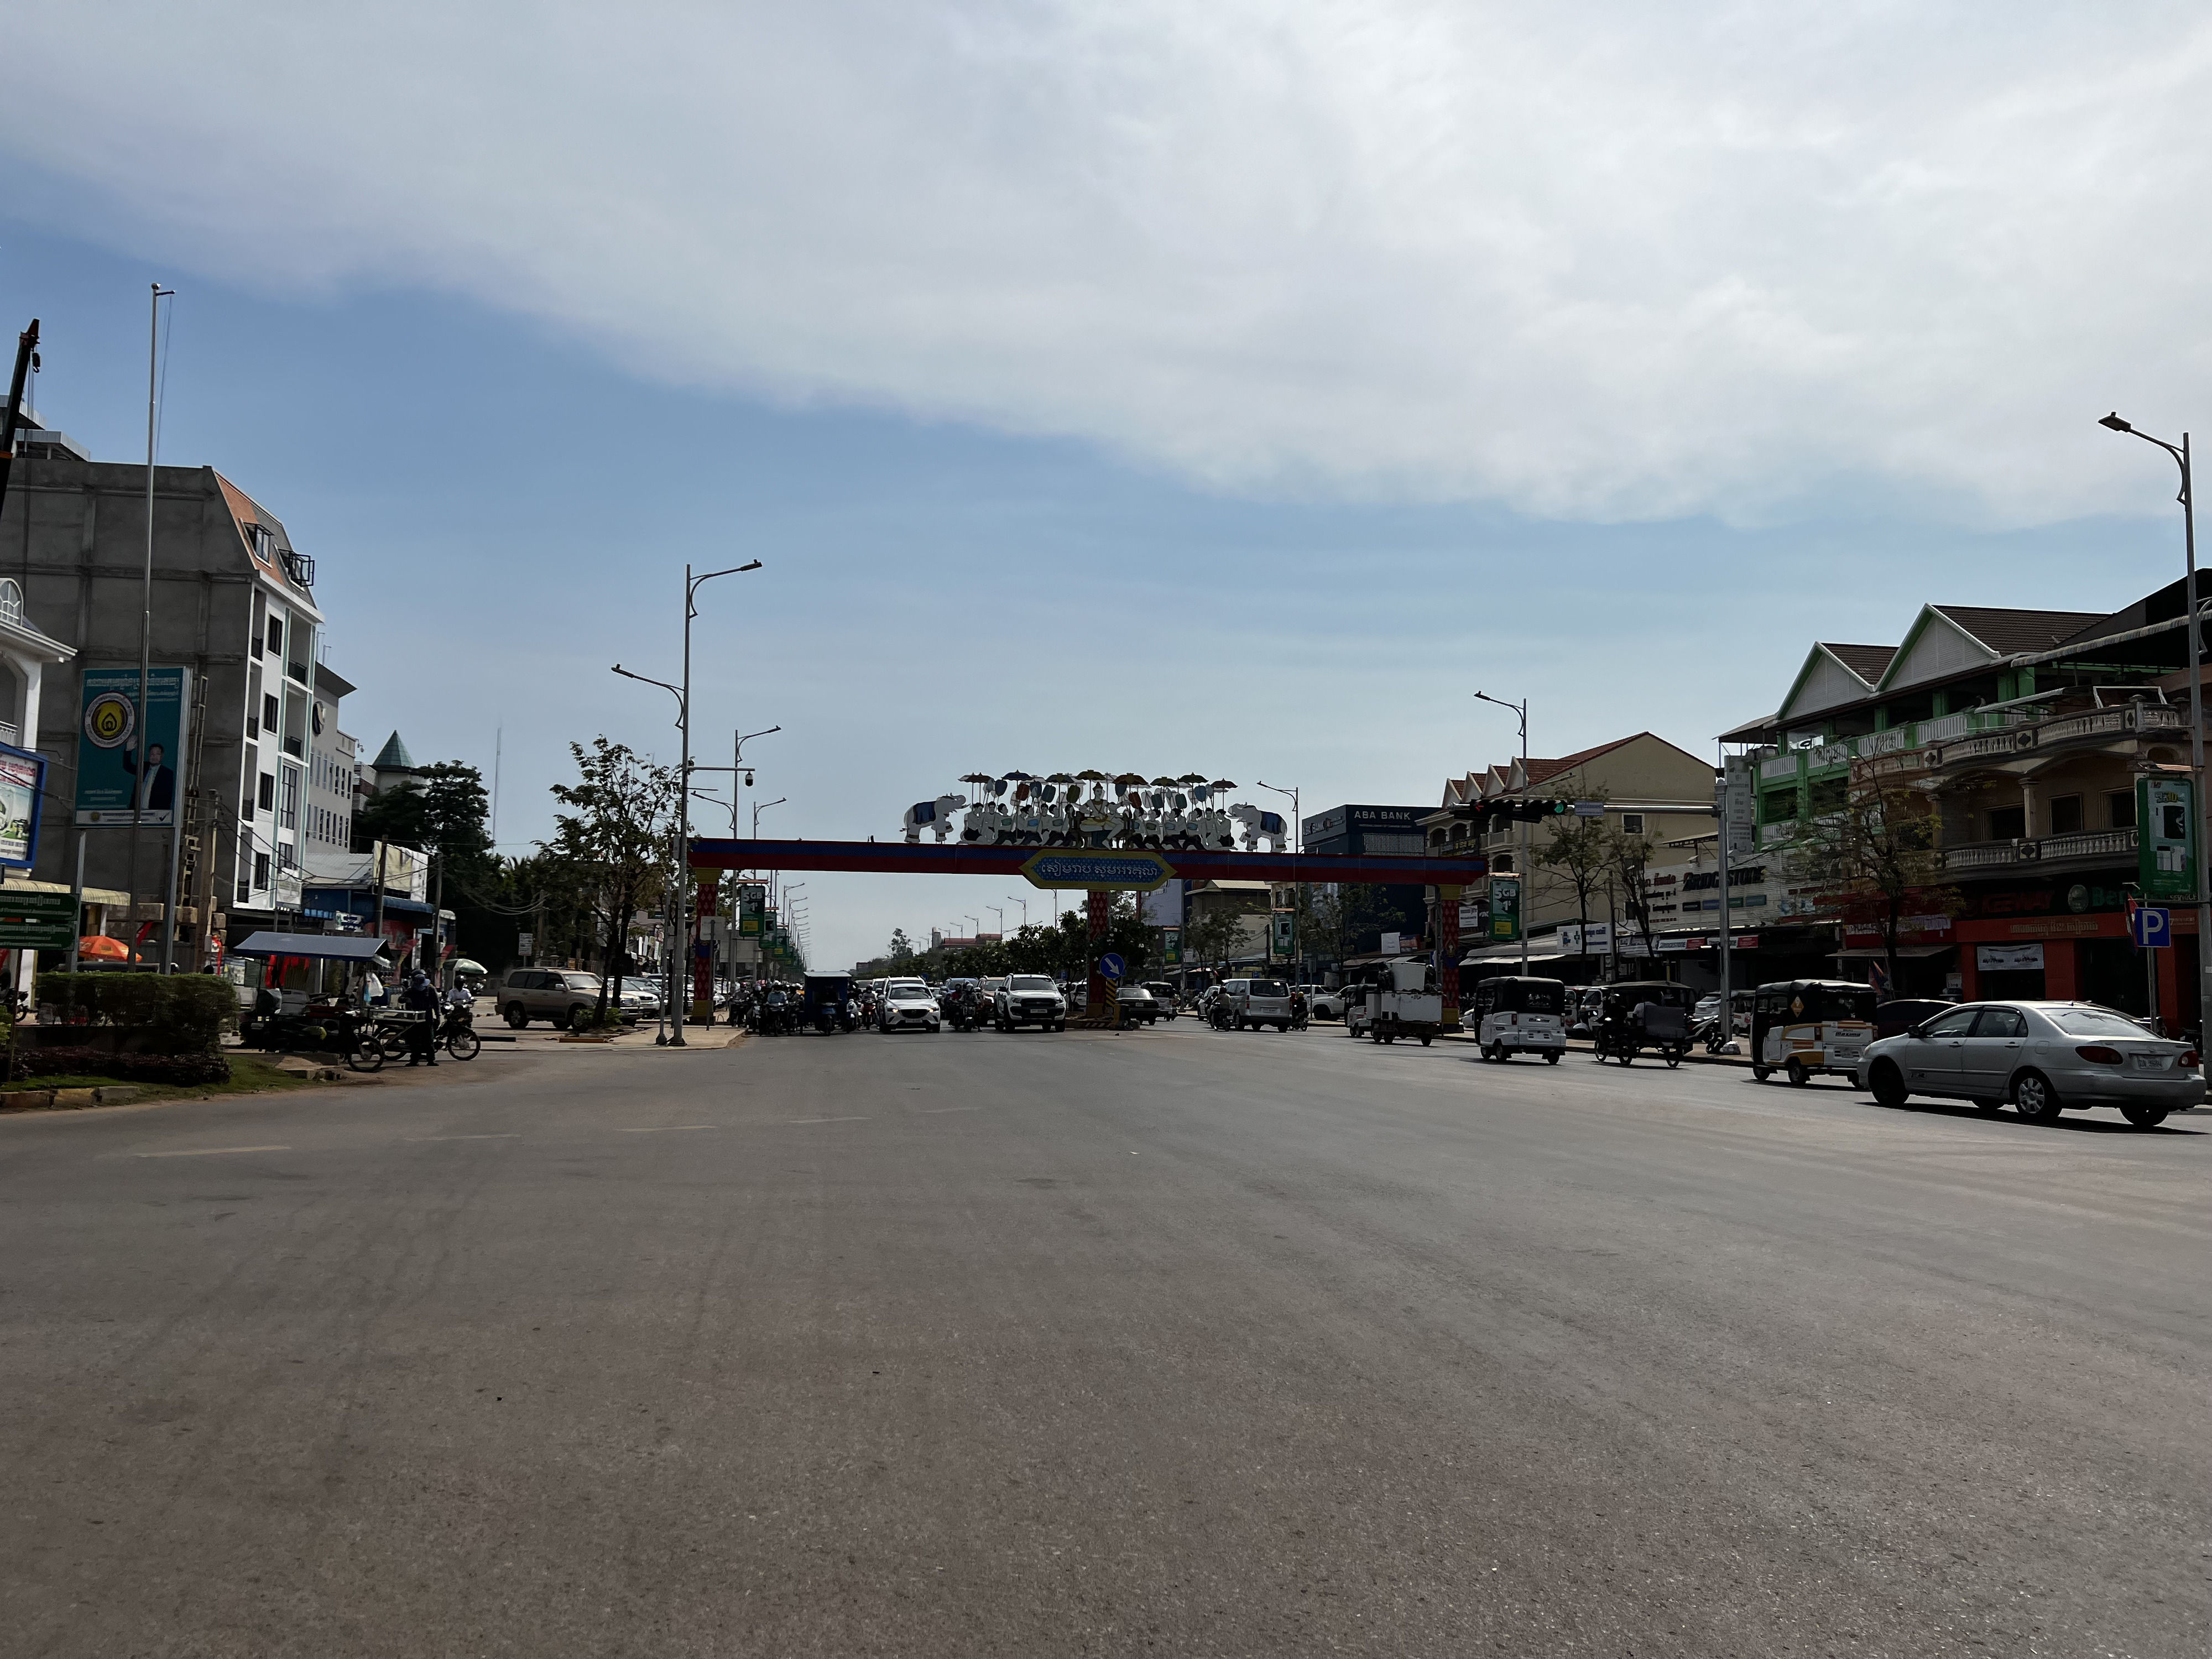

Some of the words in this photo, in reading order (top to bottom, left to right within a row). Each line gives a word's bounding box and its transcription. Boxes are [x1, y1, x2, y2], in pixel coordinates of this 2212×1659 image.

[1354, 811, 1376, 820] ABA
[1381, 811, 1411, 821] BANK
[1312, 821, 1325, 834] BANK
[1041, 859, 1091, 877] សៀមរាប
[1683, 866, 1766, 891] BRIDGSTONE
[743, 892, 763, 901] 5GB
[1494, 888, 1516, 899] 5GB
[2142, 911, 2163, 945] P
